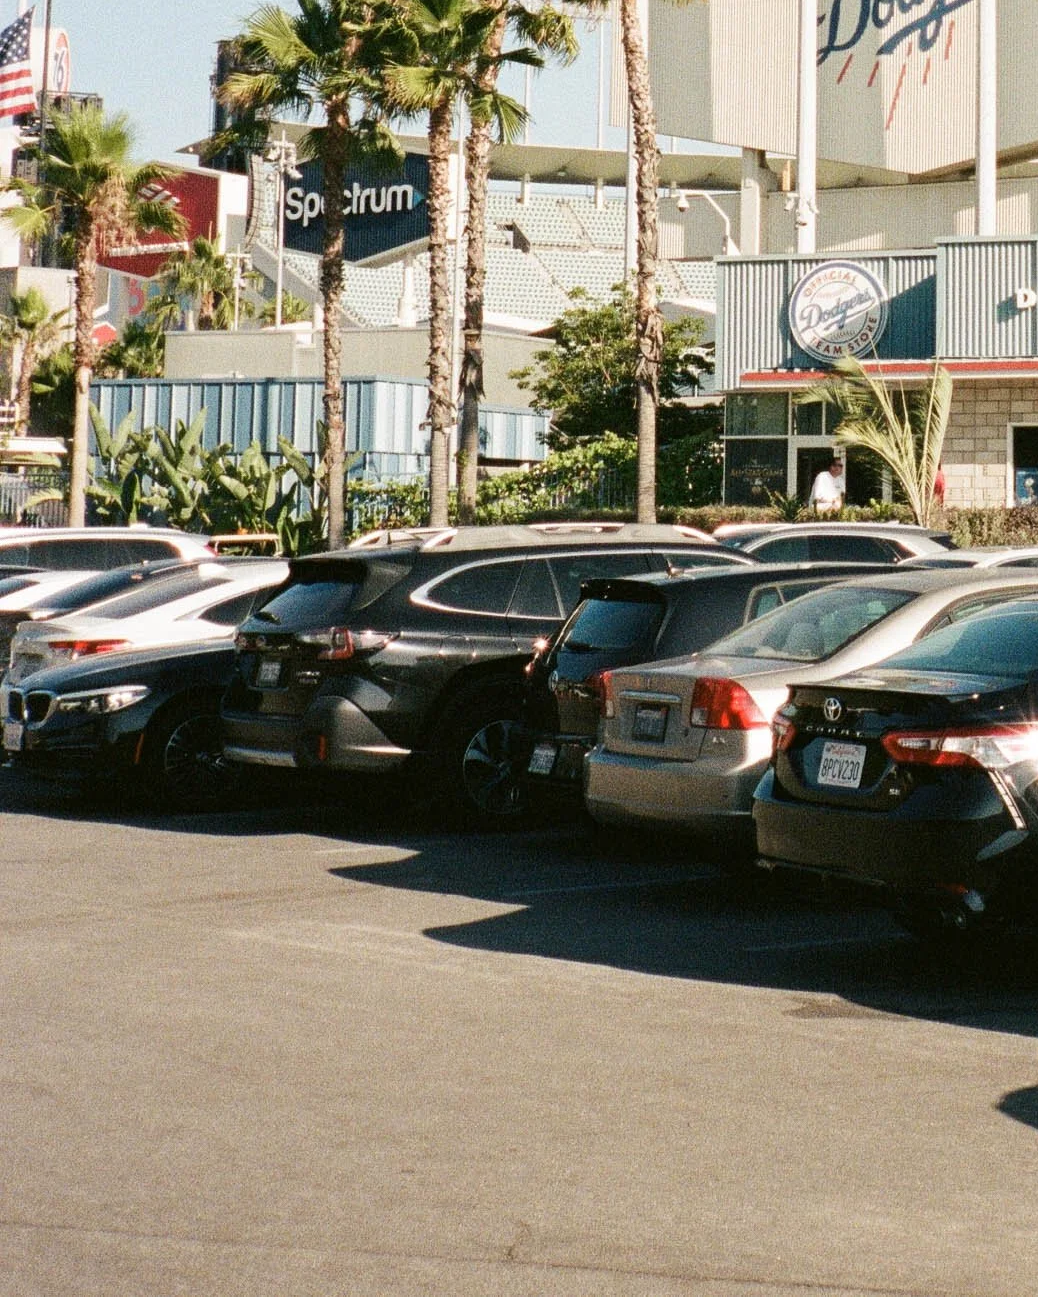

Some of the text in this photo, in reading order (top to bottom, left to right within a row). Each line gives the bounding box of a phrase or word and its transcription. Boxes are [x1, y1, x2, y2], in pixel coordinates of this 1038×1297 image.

[800, 288, 876, 335] Dodgers
[810, 316, 878, 354] TEAM STORE
